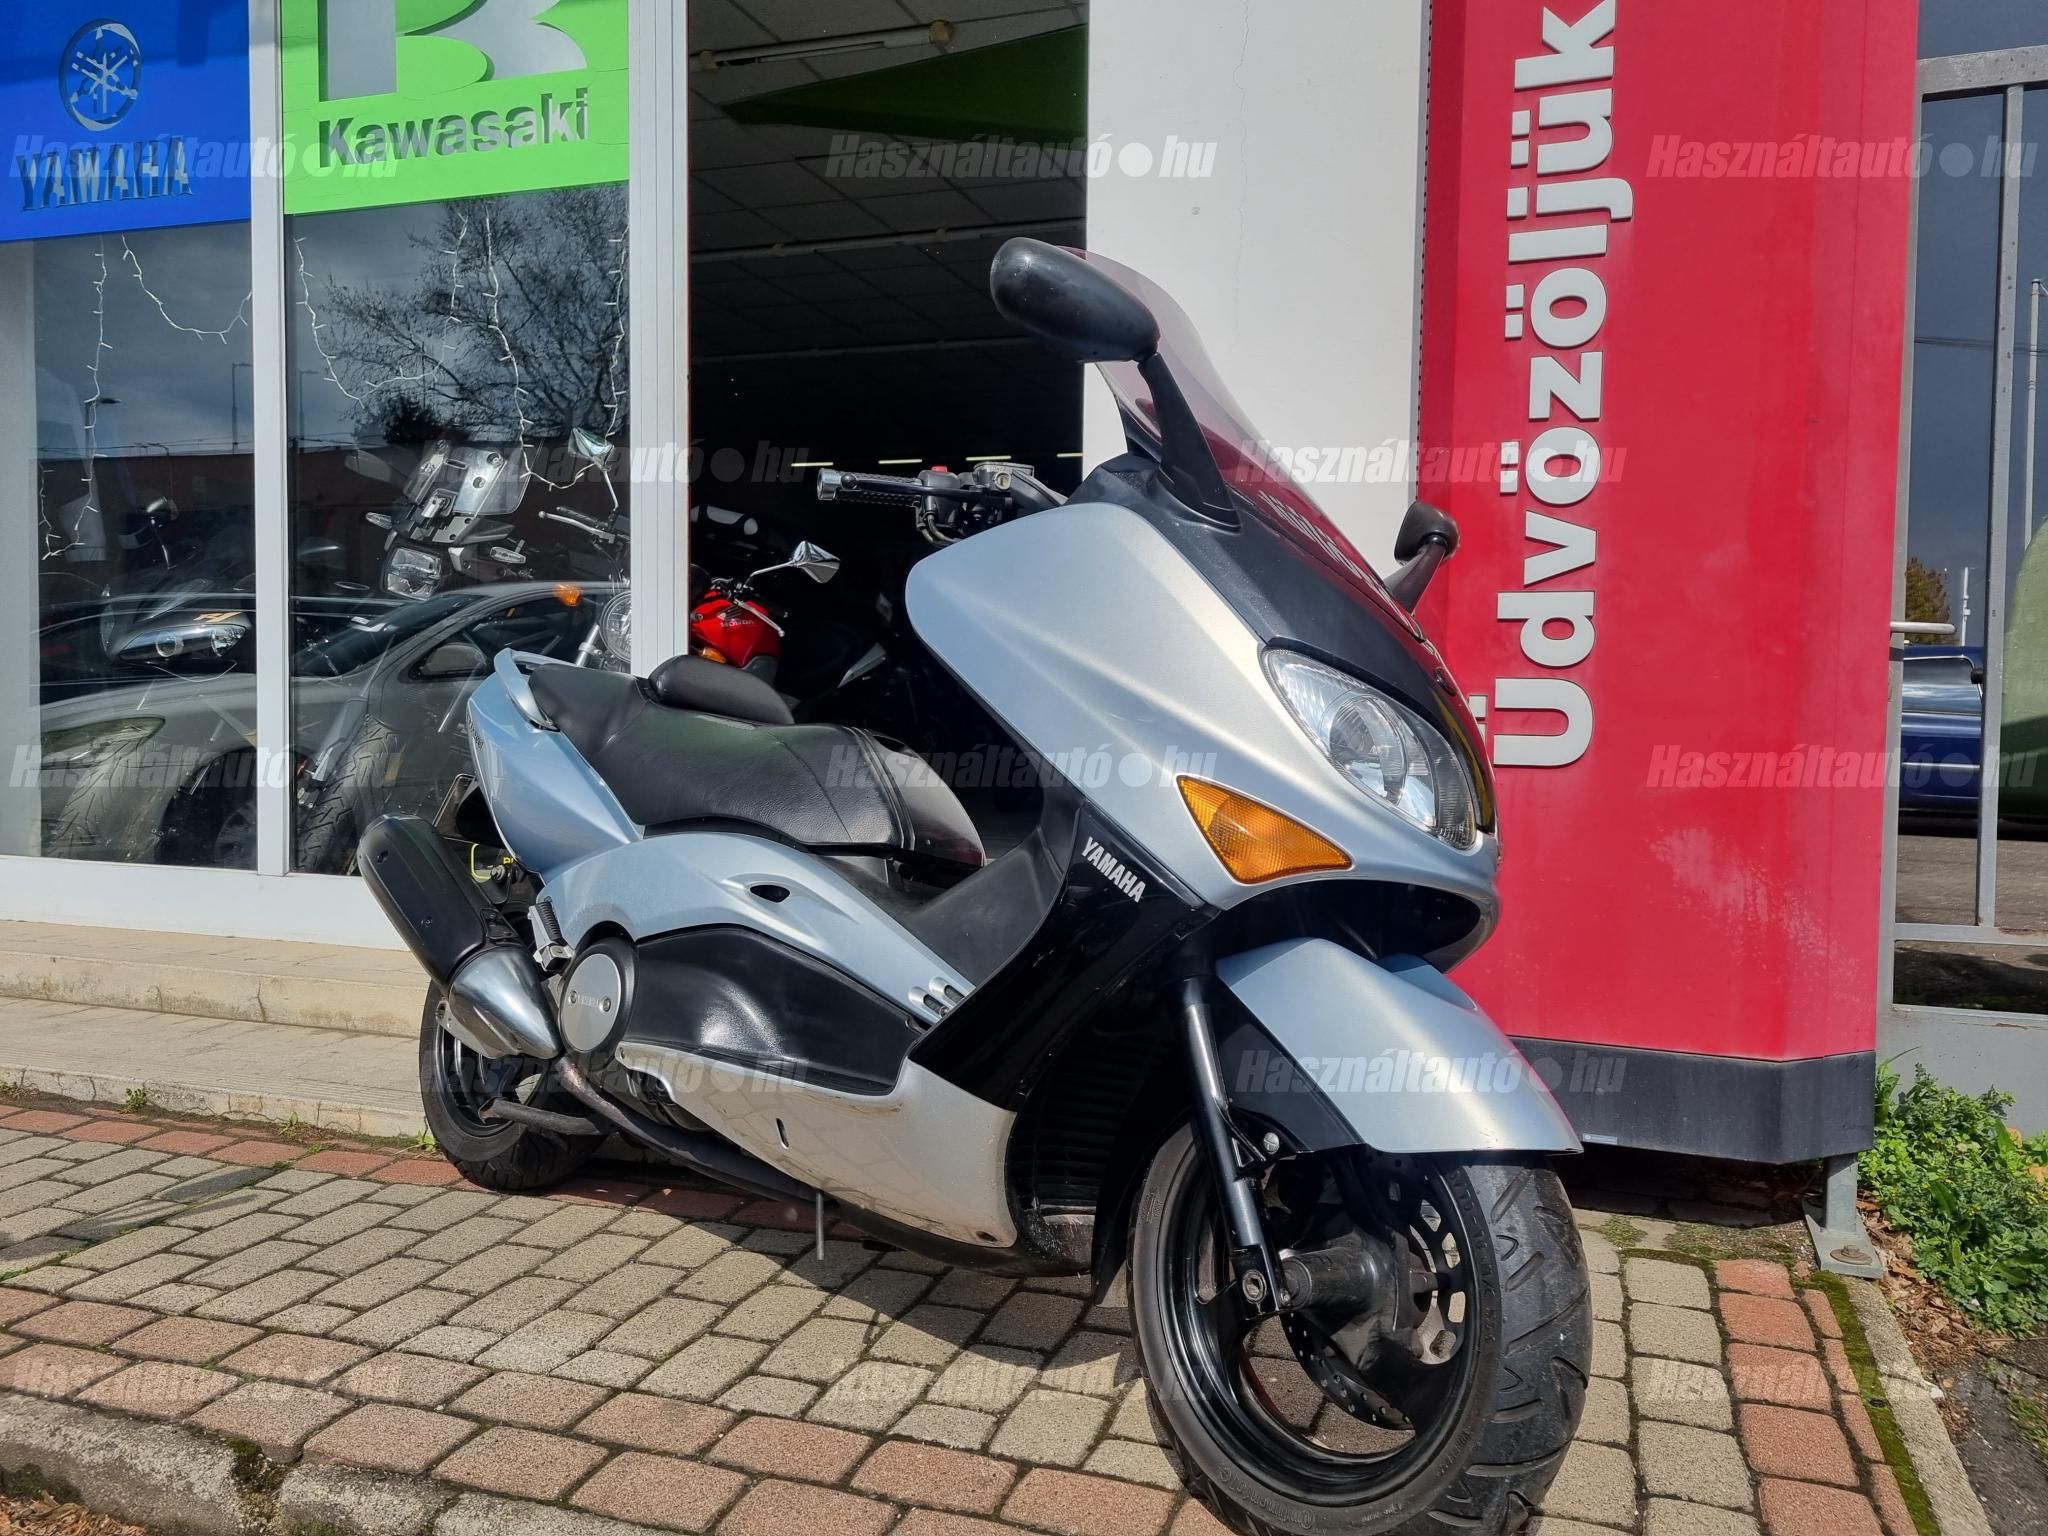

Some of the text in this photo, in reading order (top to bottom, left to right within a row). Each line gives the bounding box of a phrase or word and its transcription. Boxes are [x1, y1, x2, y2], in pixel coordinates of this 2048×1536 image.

[318, 87, 589, 168] Kawasaki
[16, 137, 193, 211] YAMAHA
[1468, 0, 1634, 768] Üdvözöljük
[1082, 836, 1146, 903] YAMAHA
